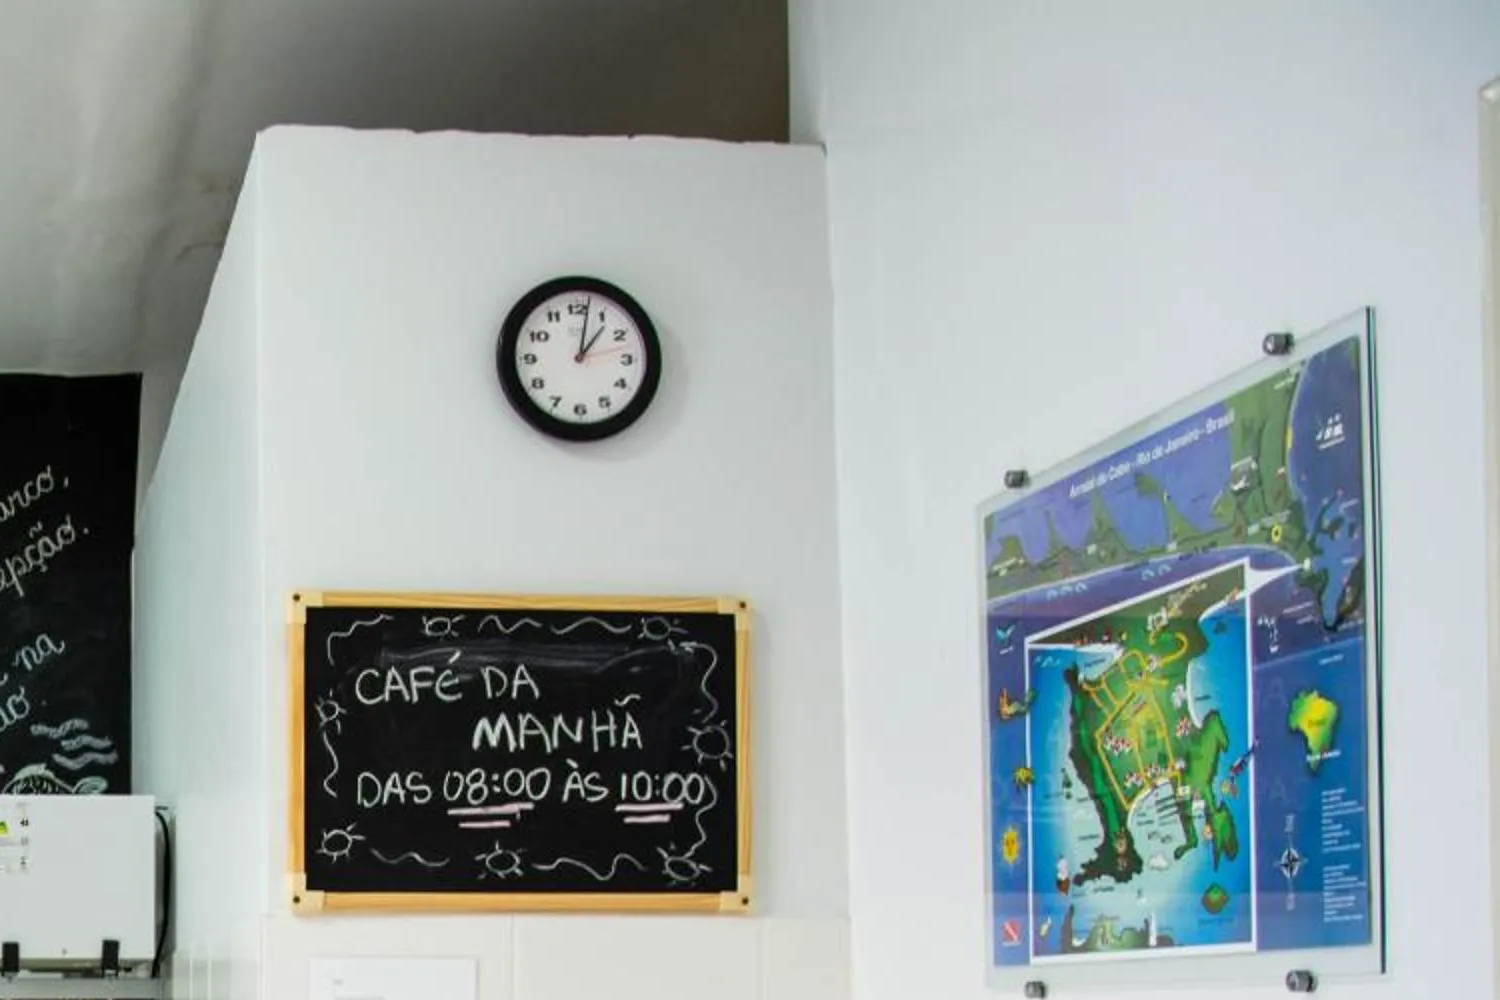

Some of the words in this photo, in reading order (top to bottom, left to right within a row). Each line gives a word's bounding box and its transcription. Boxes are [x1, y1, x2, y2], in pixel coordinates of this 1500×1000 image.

[567, 304, 588, 316] 12
[547, 311, 560, 323] 11
[599, 311, 605, 322] 1
[529, 330, 549, 343] 10
[613, 329, 626, 341] 2
[523, 353, 537, 365] 9
[620, 354, 633, 366] 3
[531, 378, 544, 389] 8
[614, 378, 627, 389] 4
[550, 396, 562, 408] 7
[598, 396, 611, 408] 5
[573, 404, 587, 416] 6
[12, 634, 65, 671] na
[355, 650, 463, 705] CAFÉ
[481, 664, 540, 699] DA
[472, 694, 643, 753] MANHÃ
[357, 771, 432, 808] DAS
[443, 767, 551, 805] 08:00
[562, 759, 609, 803] ÀS
[620, 771, 705, 804] 10:00
